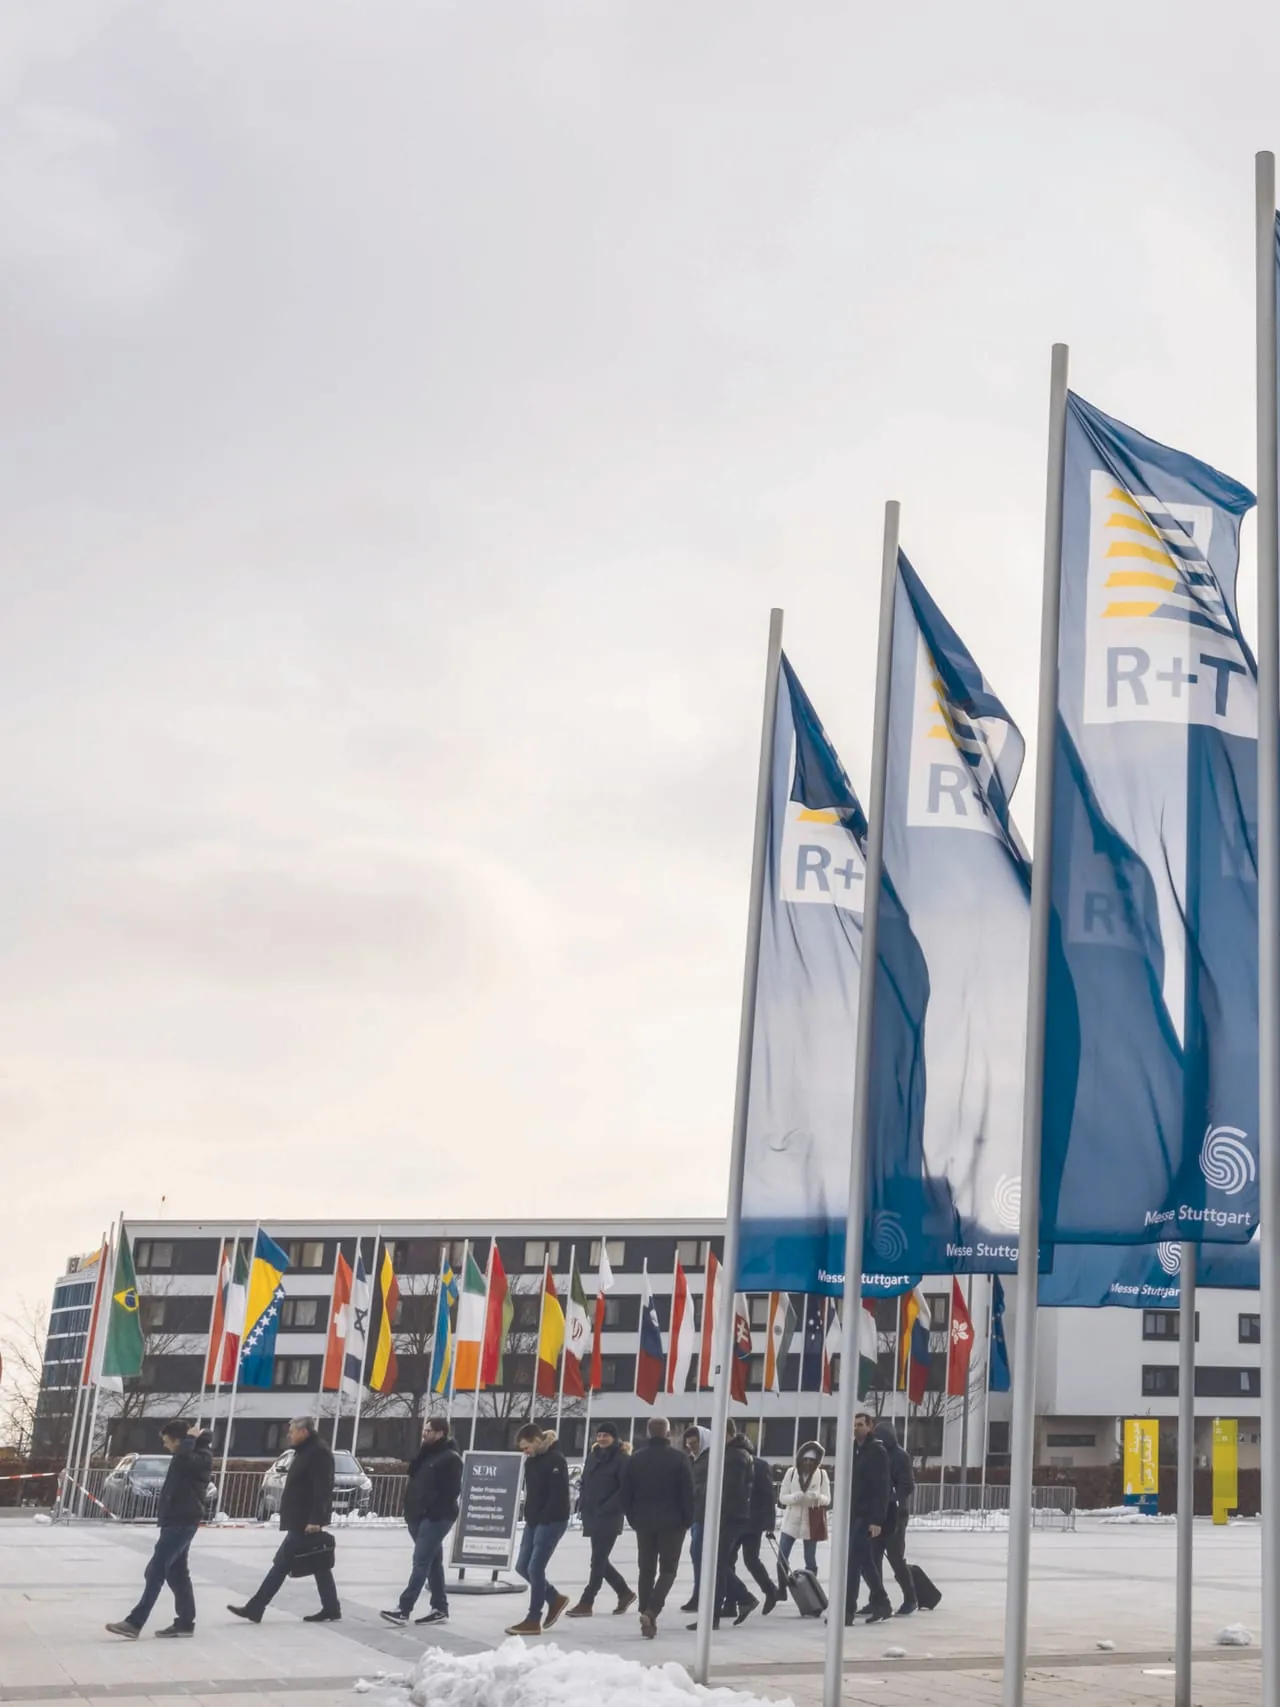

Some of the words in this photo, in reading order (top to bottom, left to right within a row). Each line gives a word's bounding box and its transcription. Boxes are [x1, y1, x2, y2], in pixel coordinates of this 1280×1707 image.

[1106, 646, 1247, 717] R+T
[795, 844, 864, 891] R+
[1144, 1209, 1175, 1227] Messe
[1178, 1204, 1251, 1226] Stuttgart
[861, 1274, 910, 1288] tuttgart
[1140, 1284, 1180, 1299] Stuttgar
